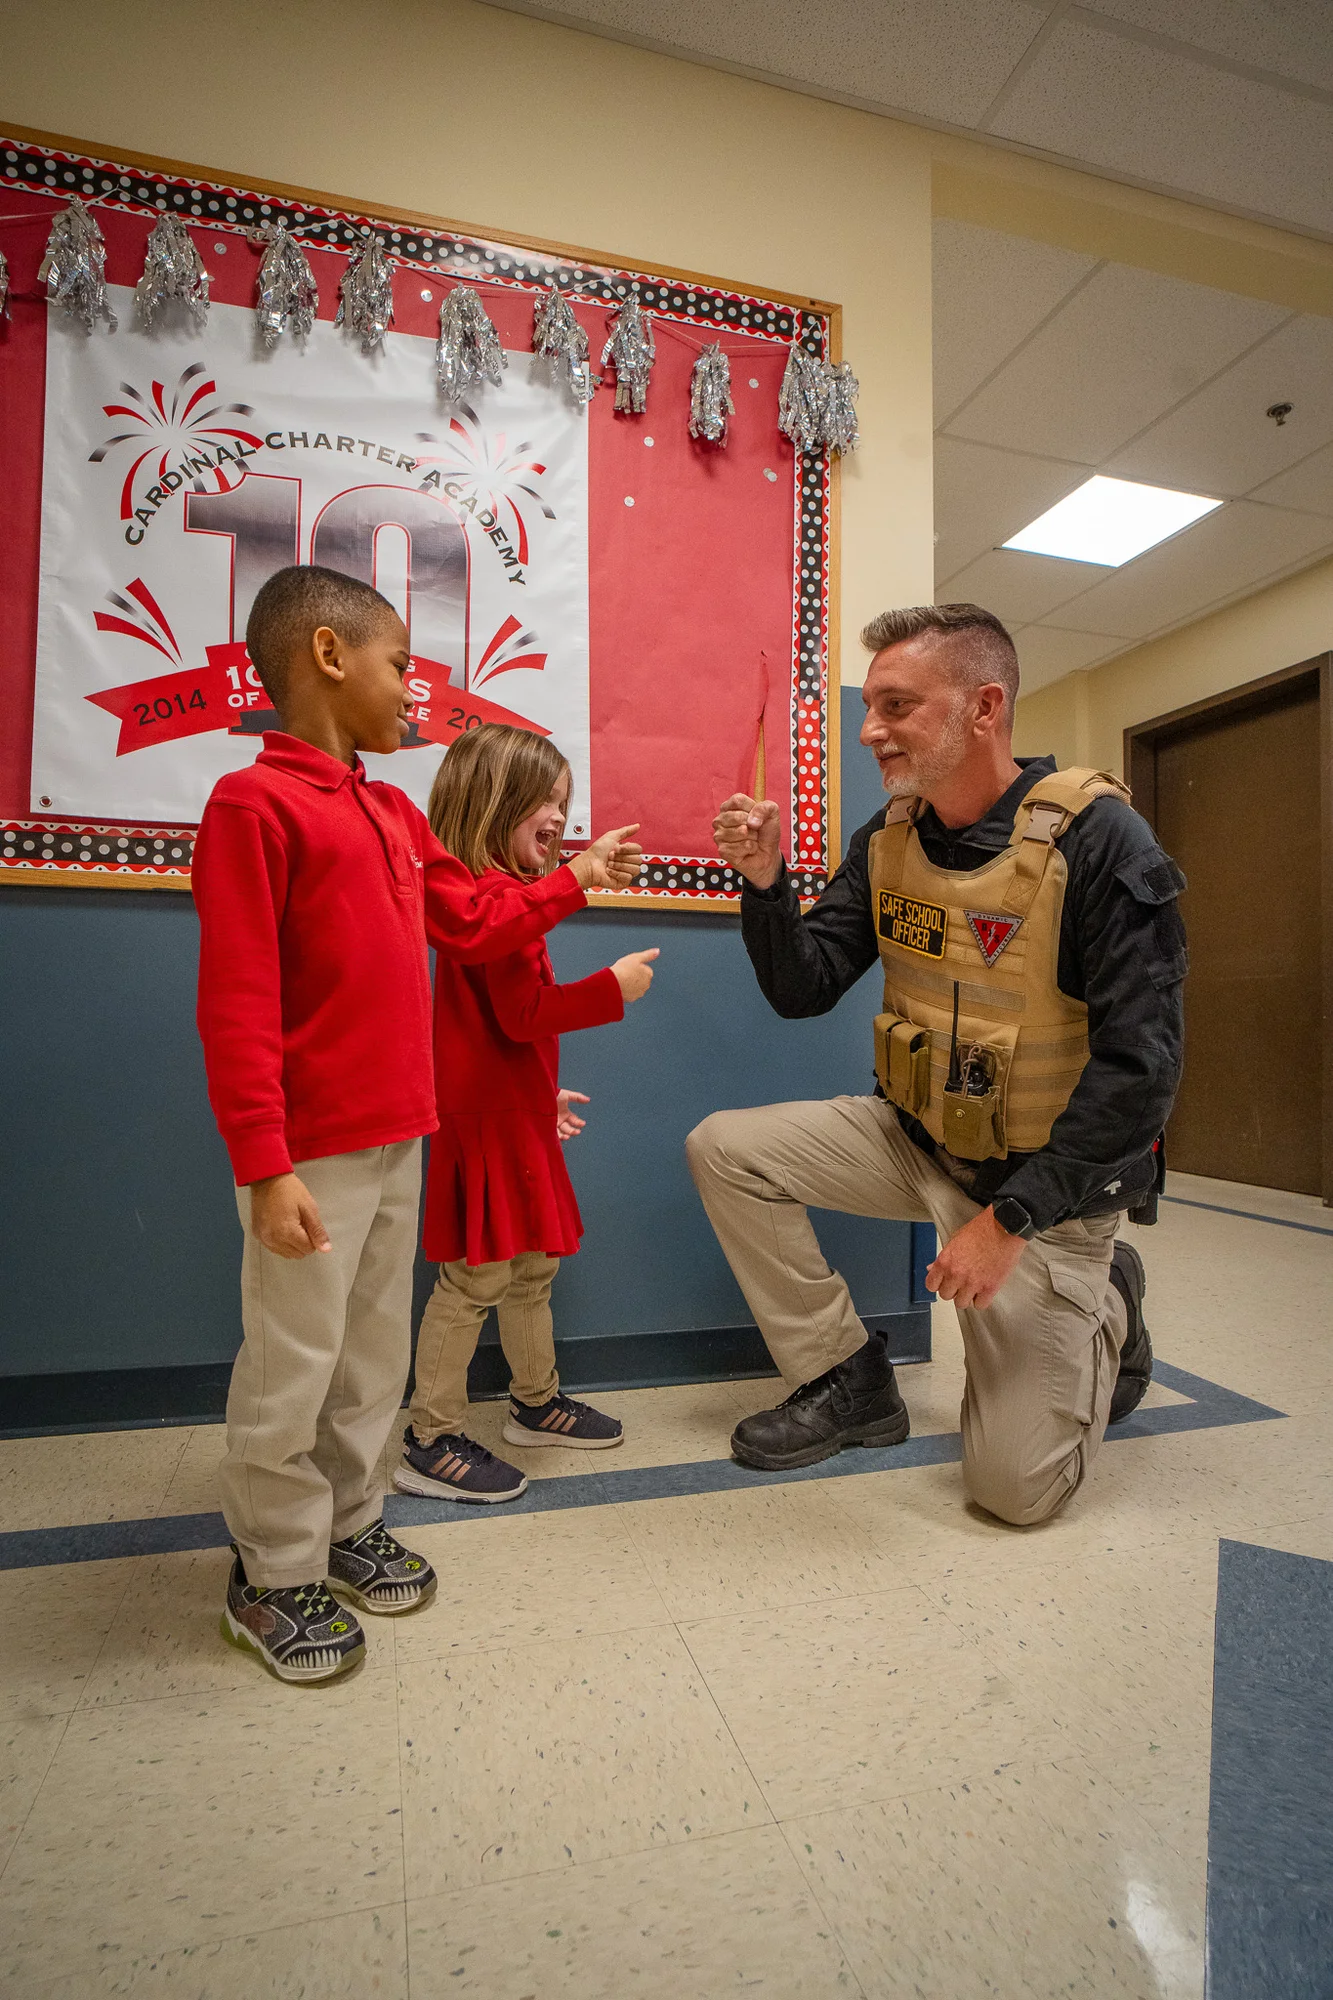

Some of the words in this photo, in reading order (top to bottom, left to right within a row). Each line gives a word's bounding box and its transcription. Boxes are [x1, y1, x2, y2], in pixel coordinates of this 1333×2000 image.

[124, 439, 256, 547] CARDINAL
[264, 431, 417, 473] CHARTER
[422, 469, 527, 587] ACADEMY
[183, 471, 472, 690] 10
[132, 688, 207, 727] 2014
[227, 691, 260, 708] OF
[881, 893, 904, 919] SAFE
[905, 901, 943, 933] SCHOOL
[977, 914, 1009, 923] DYNAMIC
[892, 919, 930, 951] OFFICER
